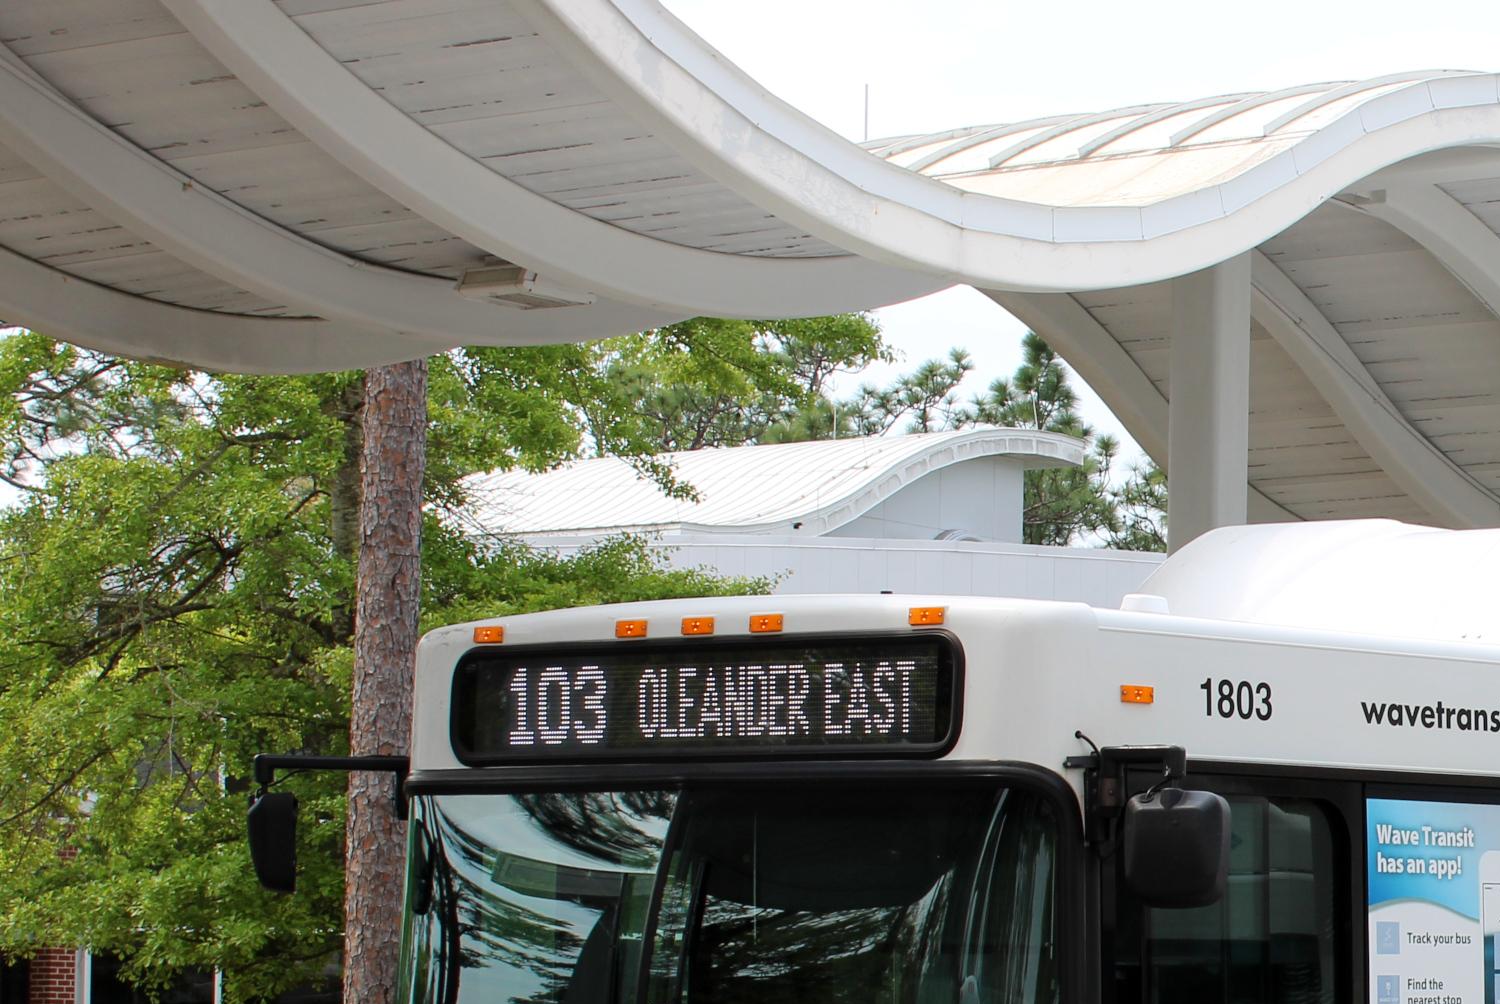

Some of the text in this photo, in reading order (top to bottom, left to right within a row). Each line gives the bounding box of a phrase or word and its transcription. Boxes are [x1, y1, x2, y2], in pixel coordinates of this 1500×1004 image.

[508, 661, 915, 745] 103 OLEANDER EAST
[1201, 677, 1273, 721] 1803
[1376, 824, 1475, 848] Wave Transit
[1376, 852, 1462, 880] has an app!
[1407, 931, 1472, 947] Track your bus
[1407, 978, 1444, 990] Find the
